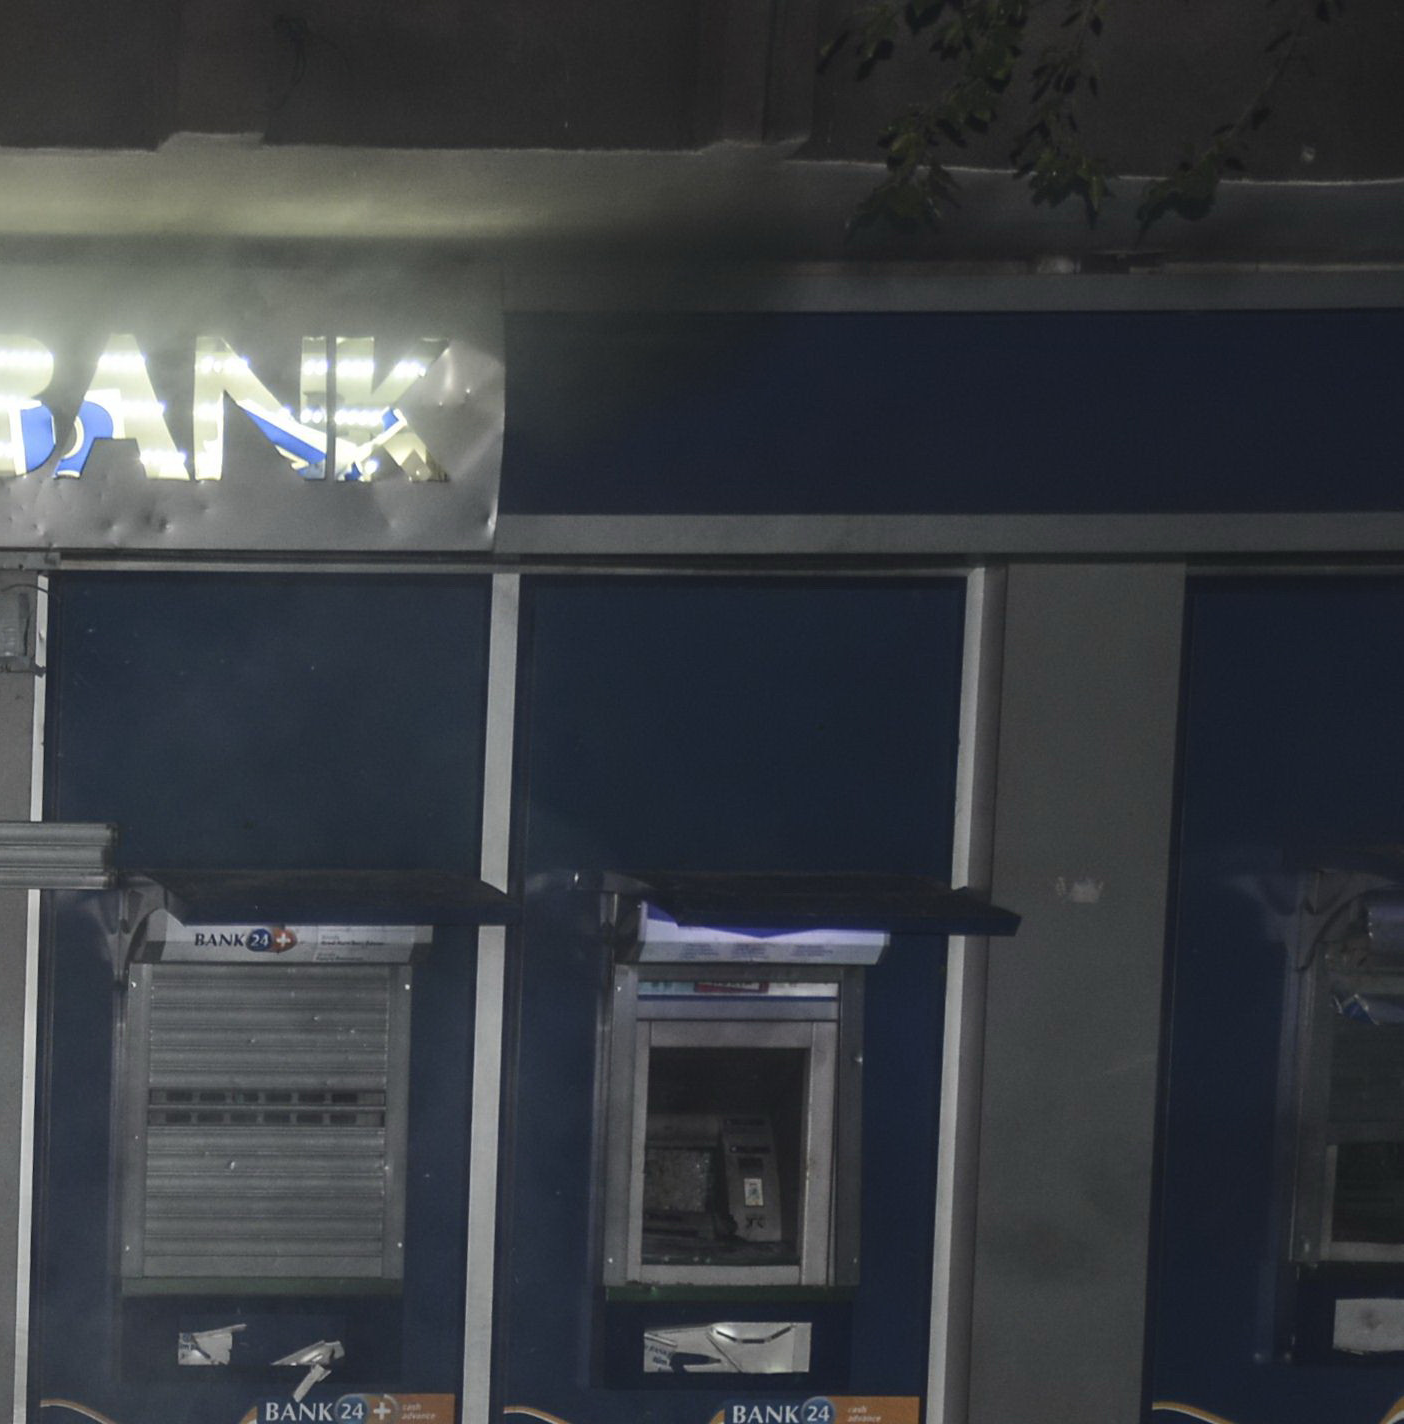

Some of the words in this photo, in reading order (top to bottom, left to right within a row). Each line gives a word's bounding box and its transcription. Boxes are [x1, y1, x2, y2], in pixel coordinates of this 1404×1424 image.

[194, 933, 246, 948] BANK
[250, 933, 270, 948] 24
[265, 1402, 334, 1422] BANK
[341, 1403, 365, 1420] 24
[732, 1405, 800, 1424] BANK
[807, 1406, 831, 1422] 24
